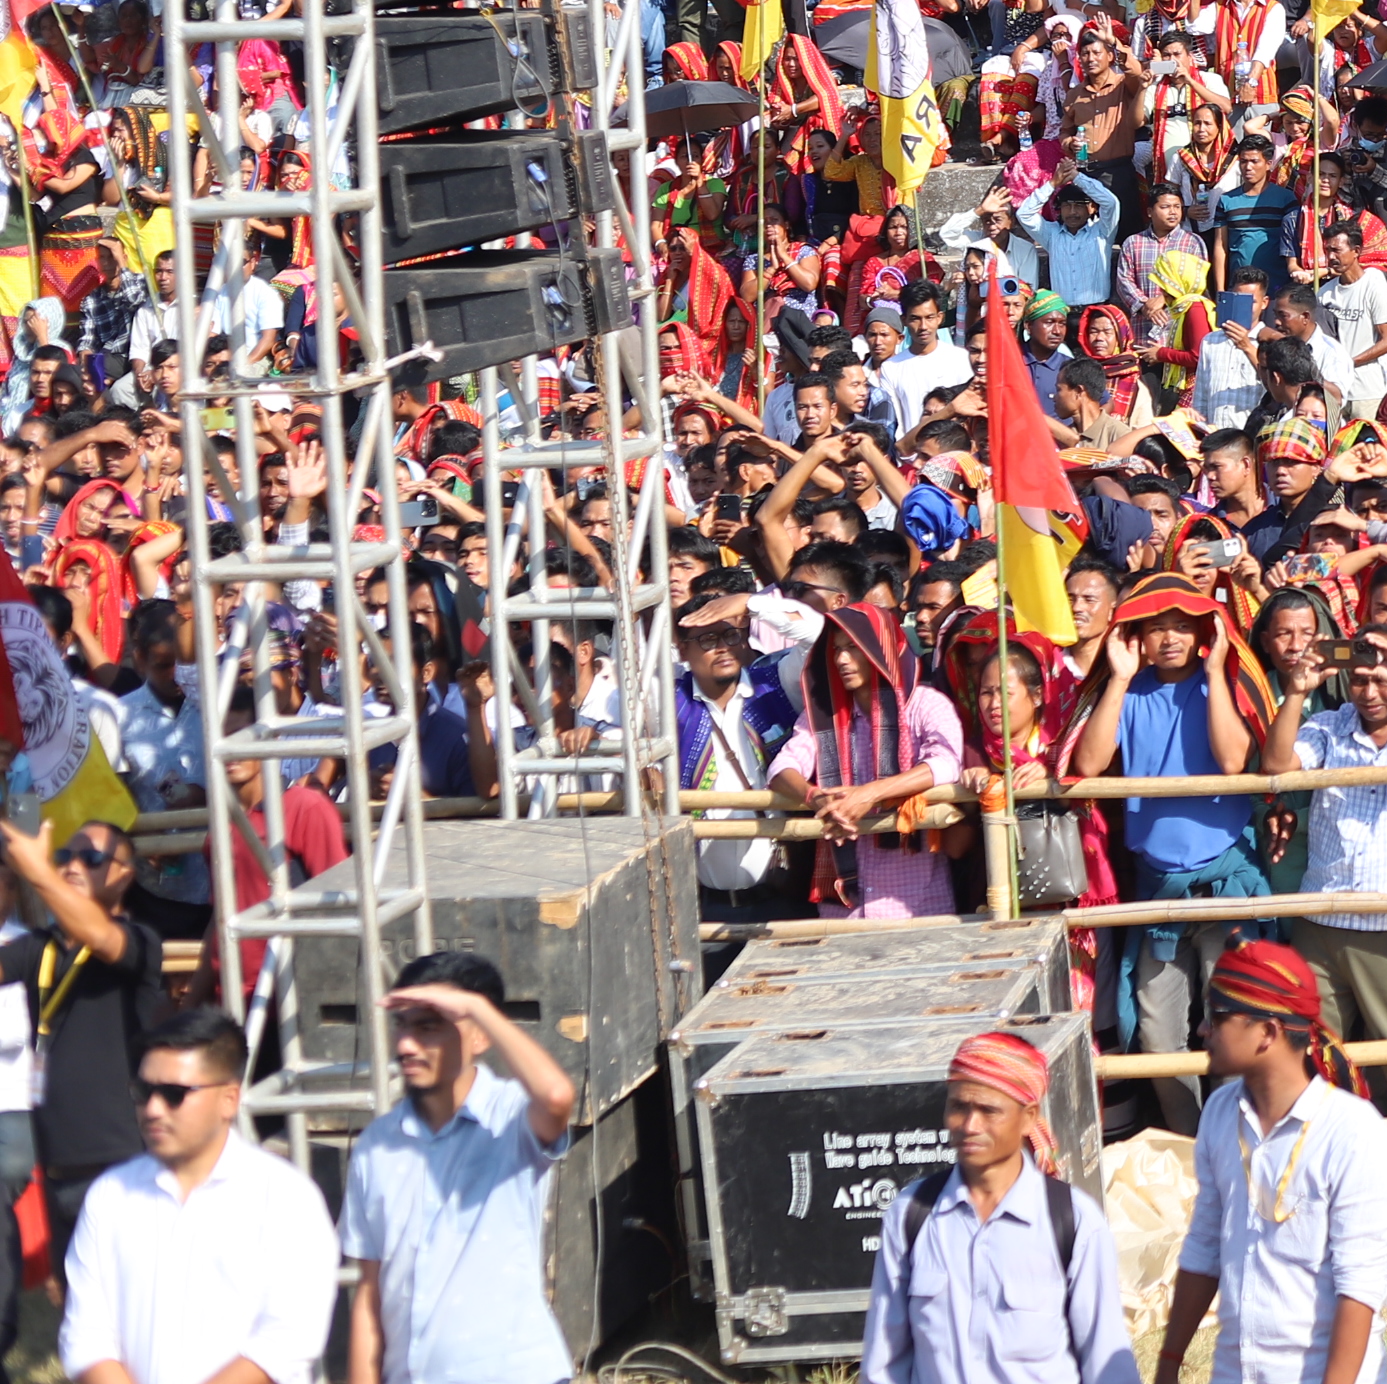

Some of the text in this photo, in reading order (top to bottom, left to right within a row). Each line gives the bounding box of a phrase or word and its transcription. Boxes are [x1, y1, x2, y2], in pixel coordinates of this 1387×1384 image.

[823, 1131, 853, 1150] Line
[856, 1132, 891, 1149] array
[894, 1128, 936, 1147] system
[825, 1144, 958, 1169] Wave guide Technolog
